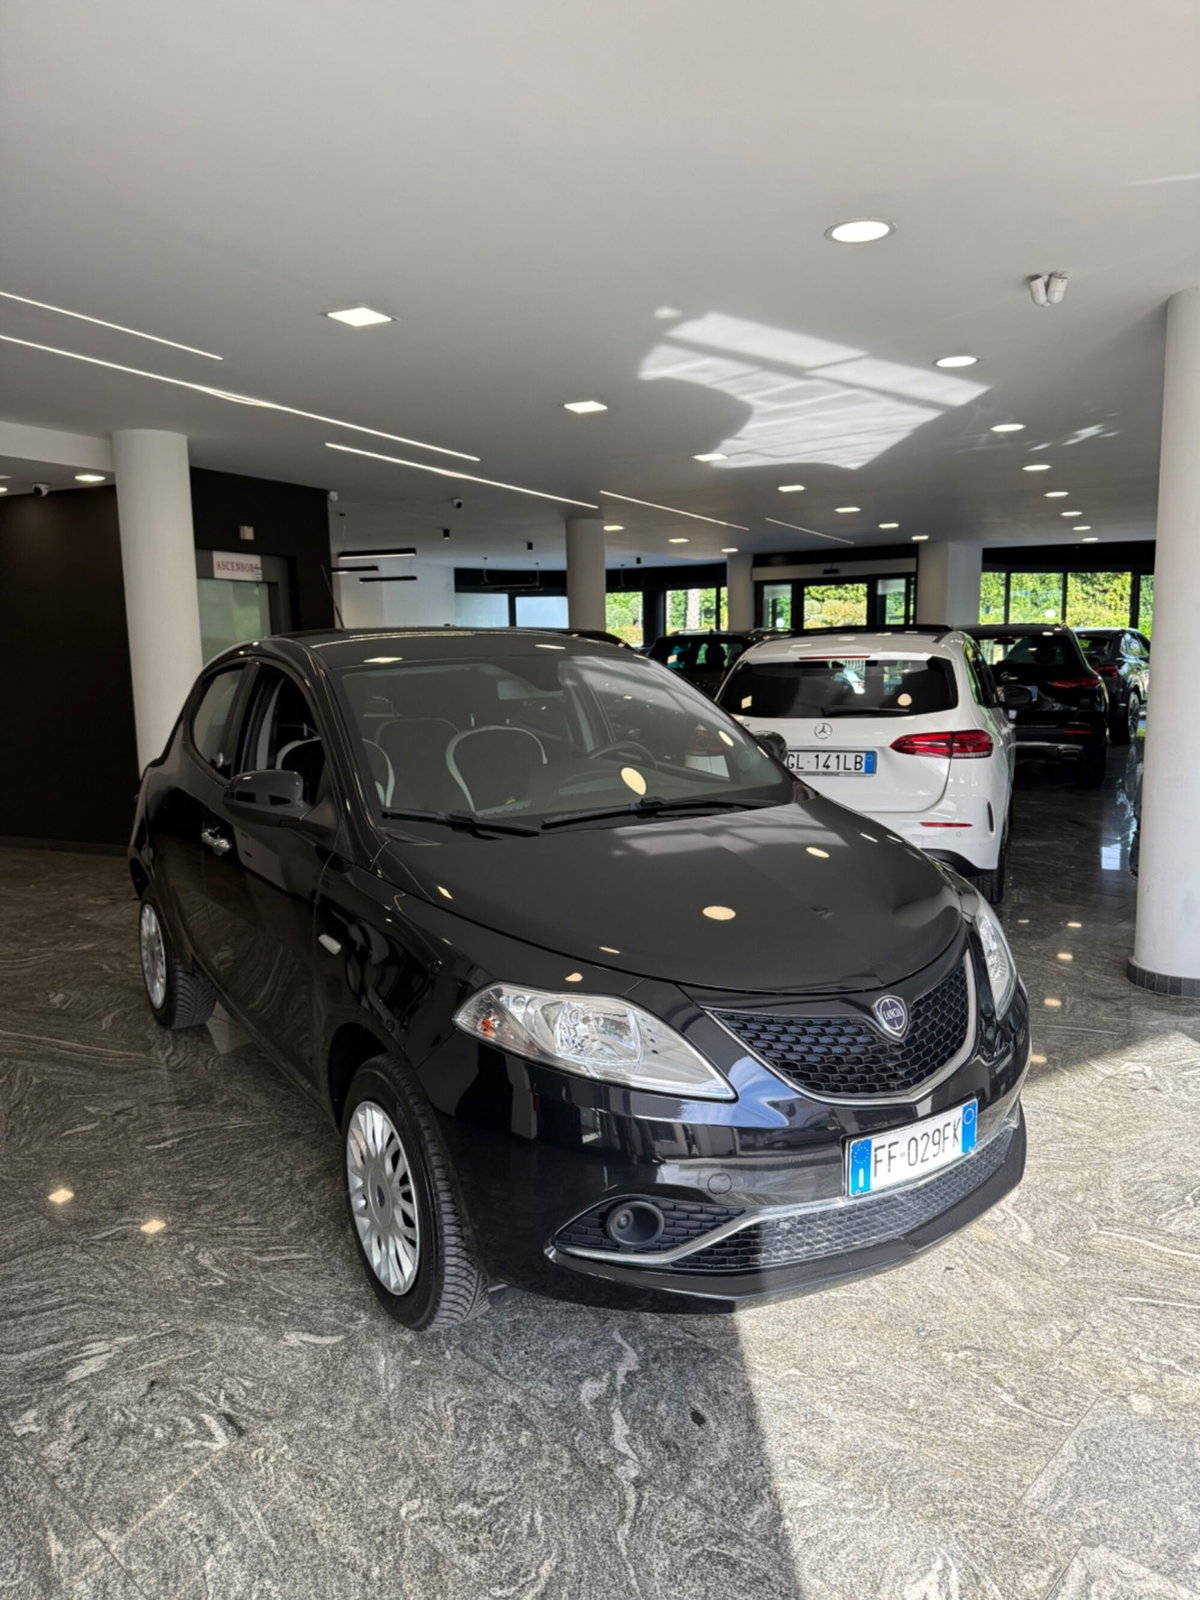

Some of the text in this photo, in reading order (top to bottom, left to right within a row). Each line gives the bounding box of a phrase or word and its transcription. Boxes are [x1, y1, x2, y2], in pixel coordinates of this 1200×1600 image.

[787, 754, 863, 771] GL 141LB
[874, 1118, 961, 1178] FF 029FK
